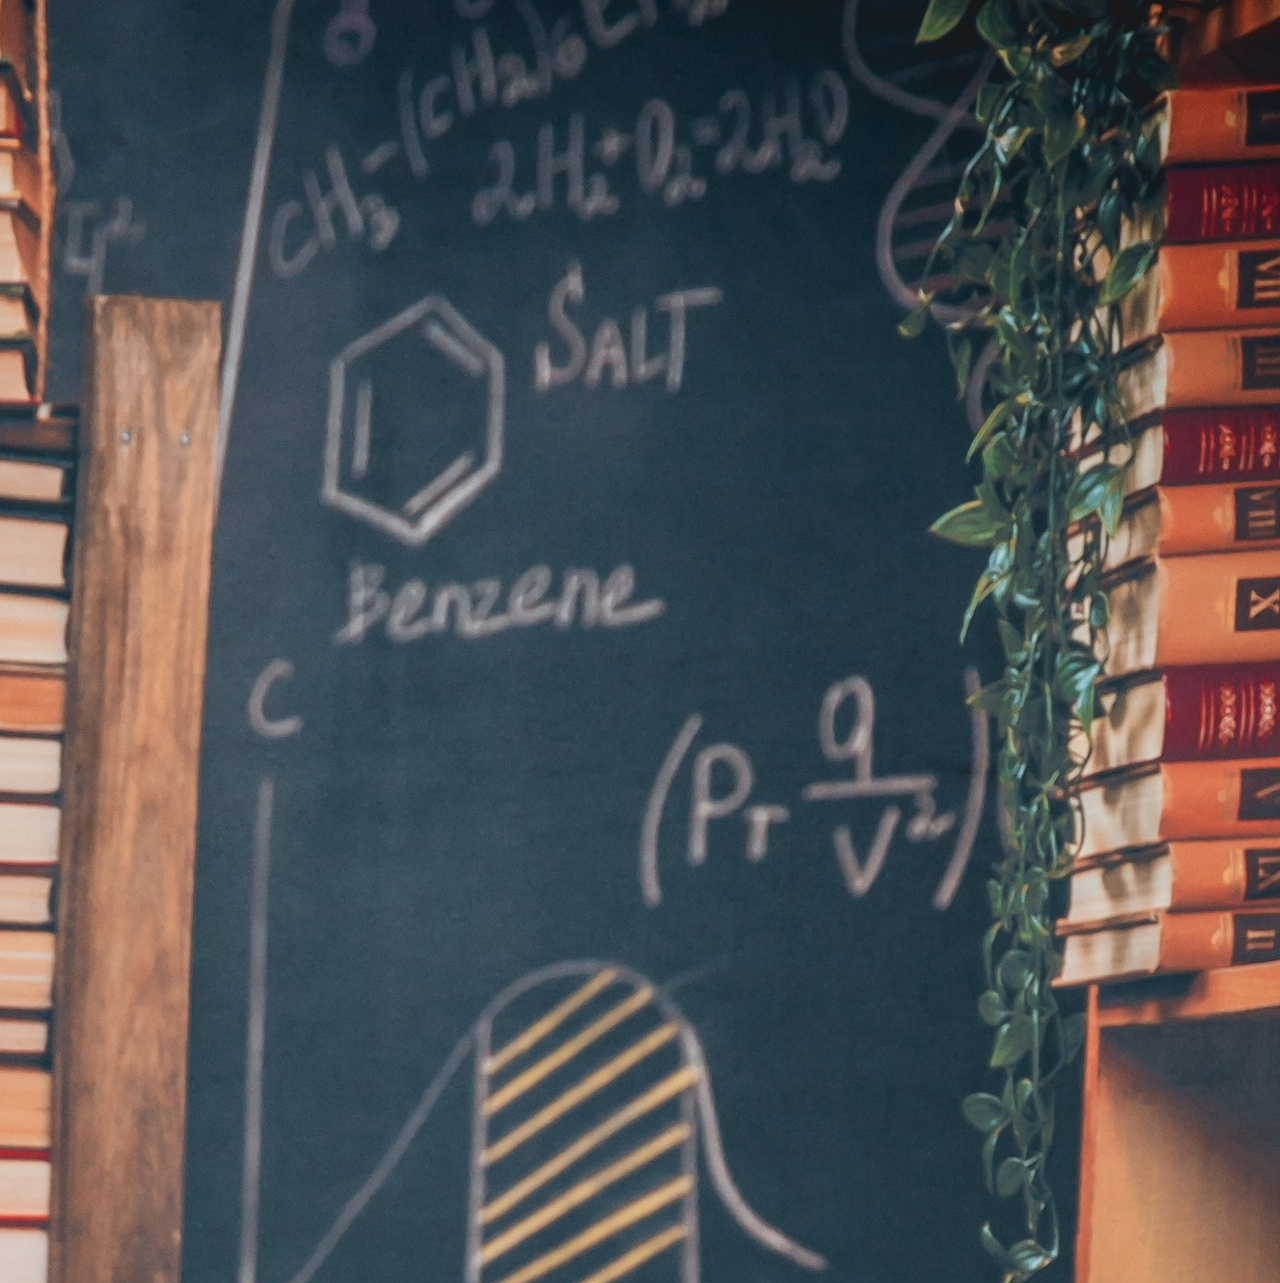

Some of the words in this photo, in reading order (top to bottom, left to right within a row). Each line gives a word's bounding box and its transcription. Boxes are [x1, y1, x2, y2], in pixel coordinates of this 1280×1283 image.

[535, 259, 721, 393] SALT
[334, 560, 666, 645] Benzene
[1248, 588, 1280, 620] X
